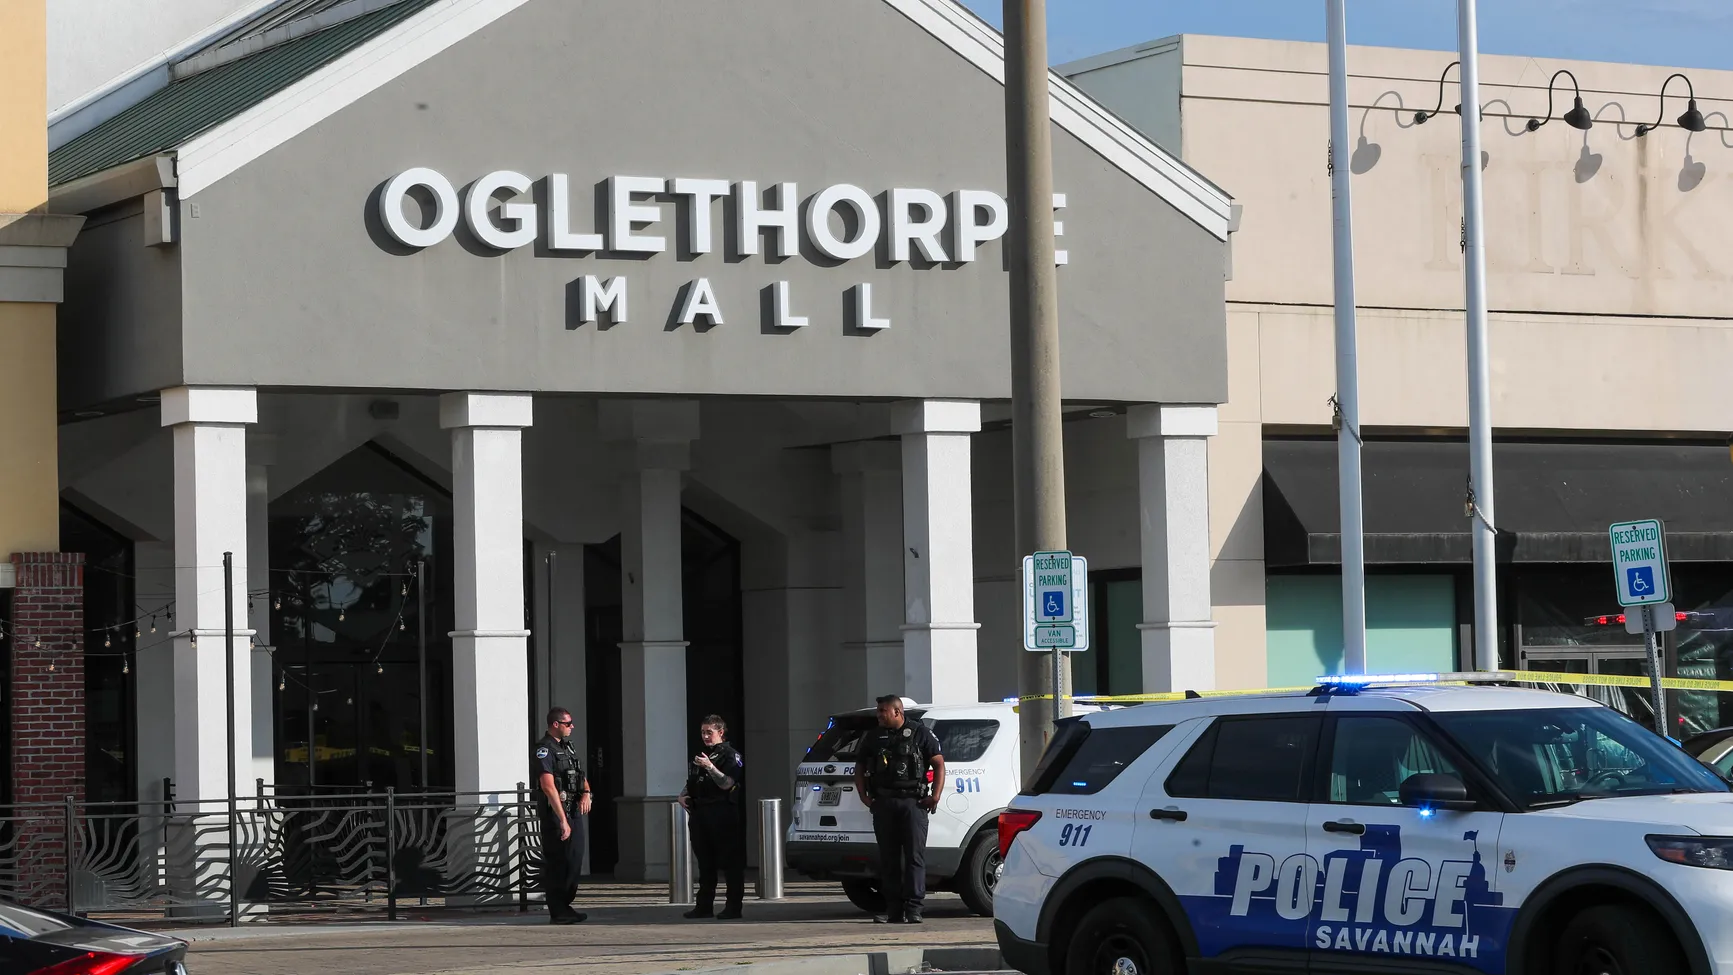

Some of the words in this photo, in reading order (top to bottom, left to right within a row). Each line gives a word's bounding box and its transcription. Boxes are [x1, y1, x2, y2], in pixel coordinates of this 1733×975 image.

[379, 167, 1068, 265] OGLETHORP
[578, 274, 891, 329] MALL
[1613, 528, 1657, 545] RESERVED
[1619, 547, 1656, 563] PARKING
[1035, 558, 1069, 570] RESERVED
[1039, 574, 1067, 586] PARKING
[945, 768, 986, 776] EMERGENCY
[955, 777, 981, 793] 911
[1055, 808, 1107, 820] EMERGENCY
[1059, 823, 1093, 847] 911
[1230, 851, 1475, 928] POLICE
[1315, 925, 1480, 959] SAVANNAH
